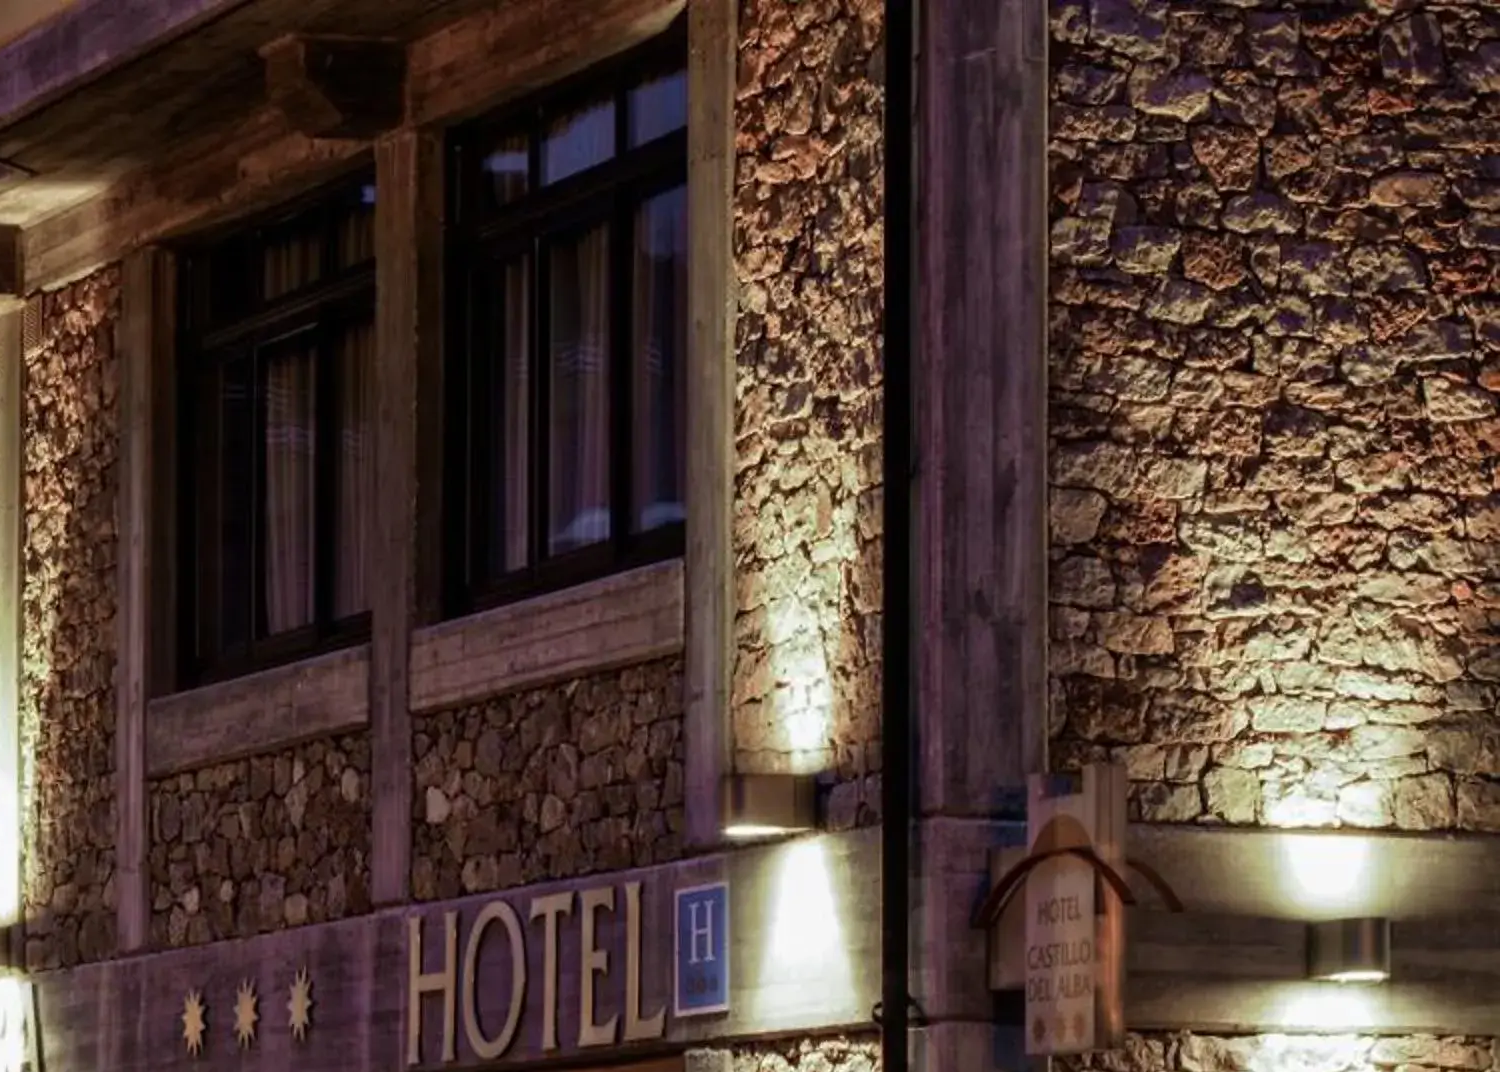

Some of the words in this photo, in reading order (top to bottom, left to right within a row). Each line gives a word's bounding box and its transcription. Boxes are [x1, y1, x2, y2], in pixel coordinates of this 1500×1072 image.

[1037, 896, 1082, 926] HOTEL
[688, 899, 716, 964] H
[1028, 942, 1092, 970] CASTILLO
[407, 881, 670, 1067] HOTEL
[1029, 978, 1054, 1002] DEL
